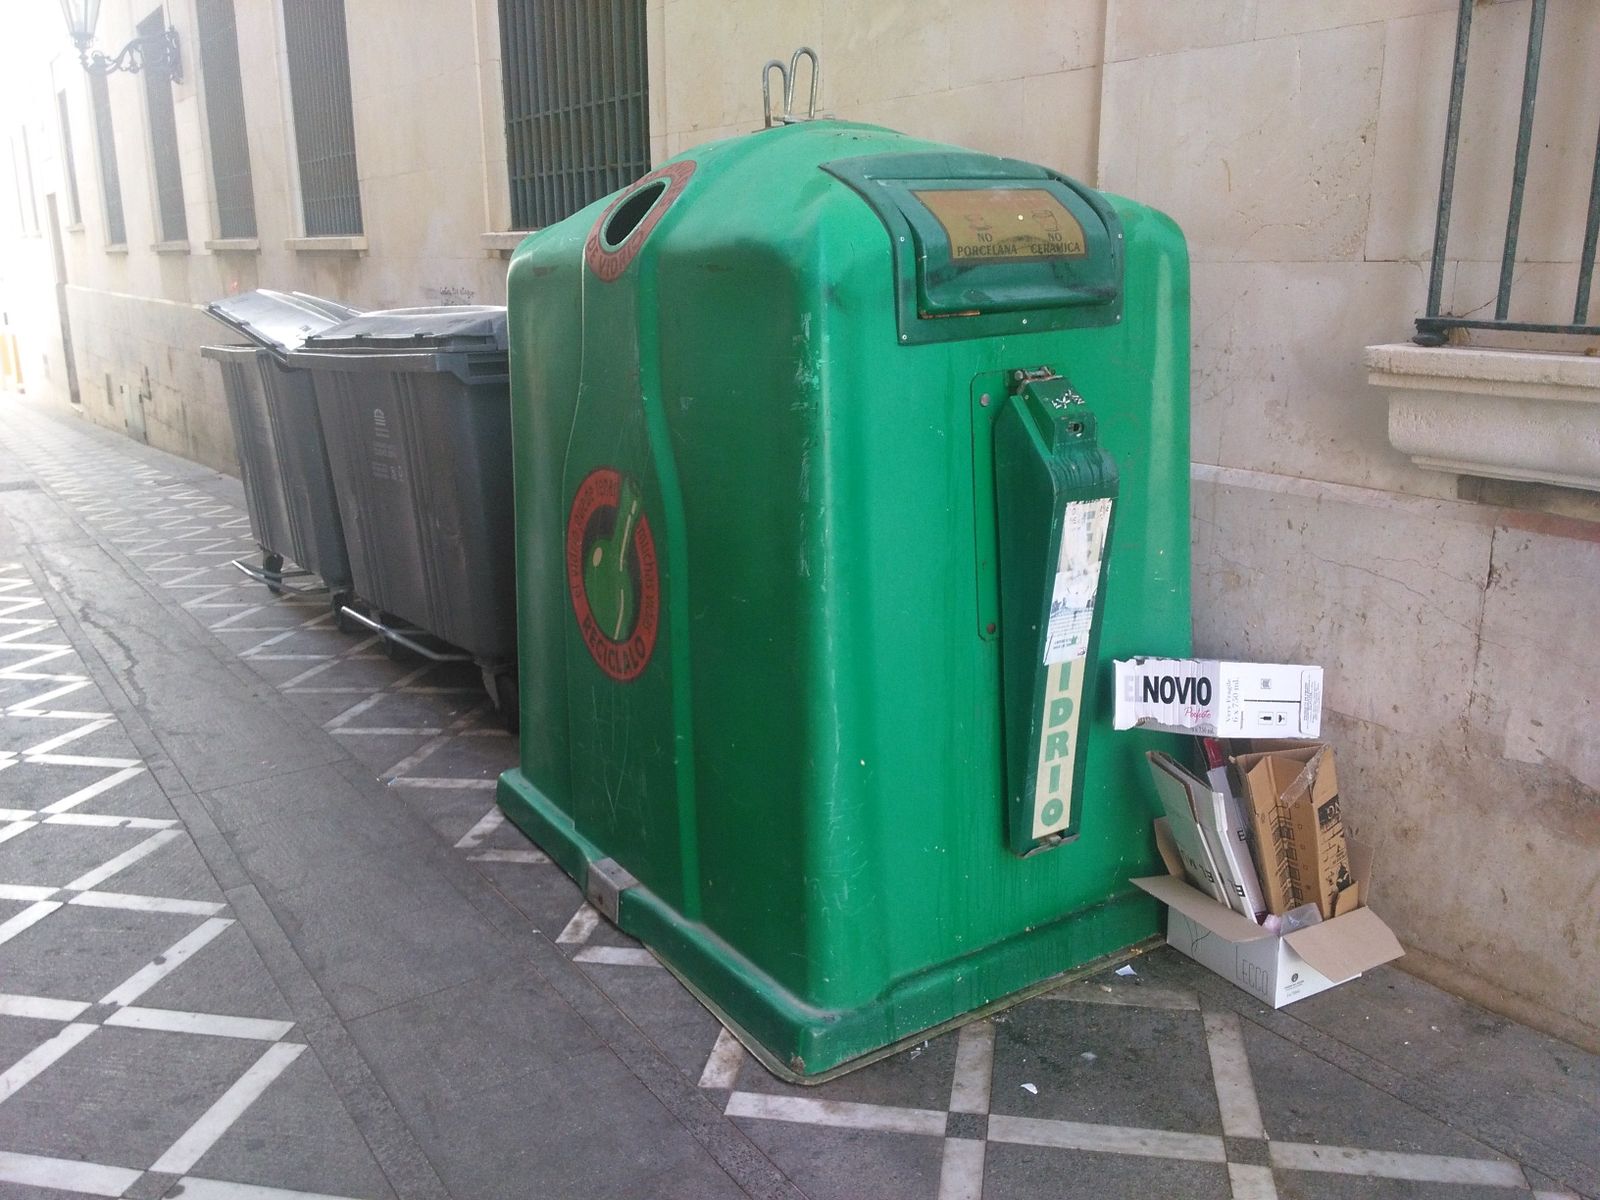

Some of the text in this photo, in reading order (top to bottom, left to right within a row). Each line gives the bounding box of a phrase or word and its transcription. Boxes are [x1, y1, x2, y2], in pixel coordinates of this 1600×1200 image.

[977, 232, 993, 242] NO
[1048, 232, 1062, 242] NO
[957, 244, 1018, 256] PORCELANA
[1143, 675, 1212, 706] NOVIO
[1235, 945, 1269, 996] LECCO
